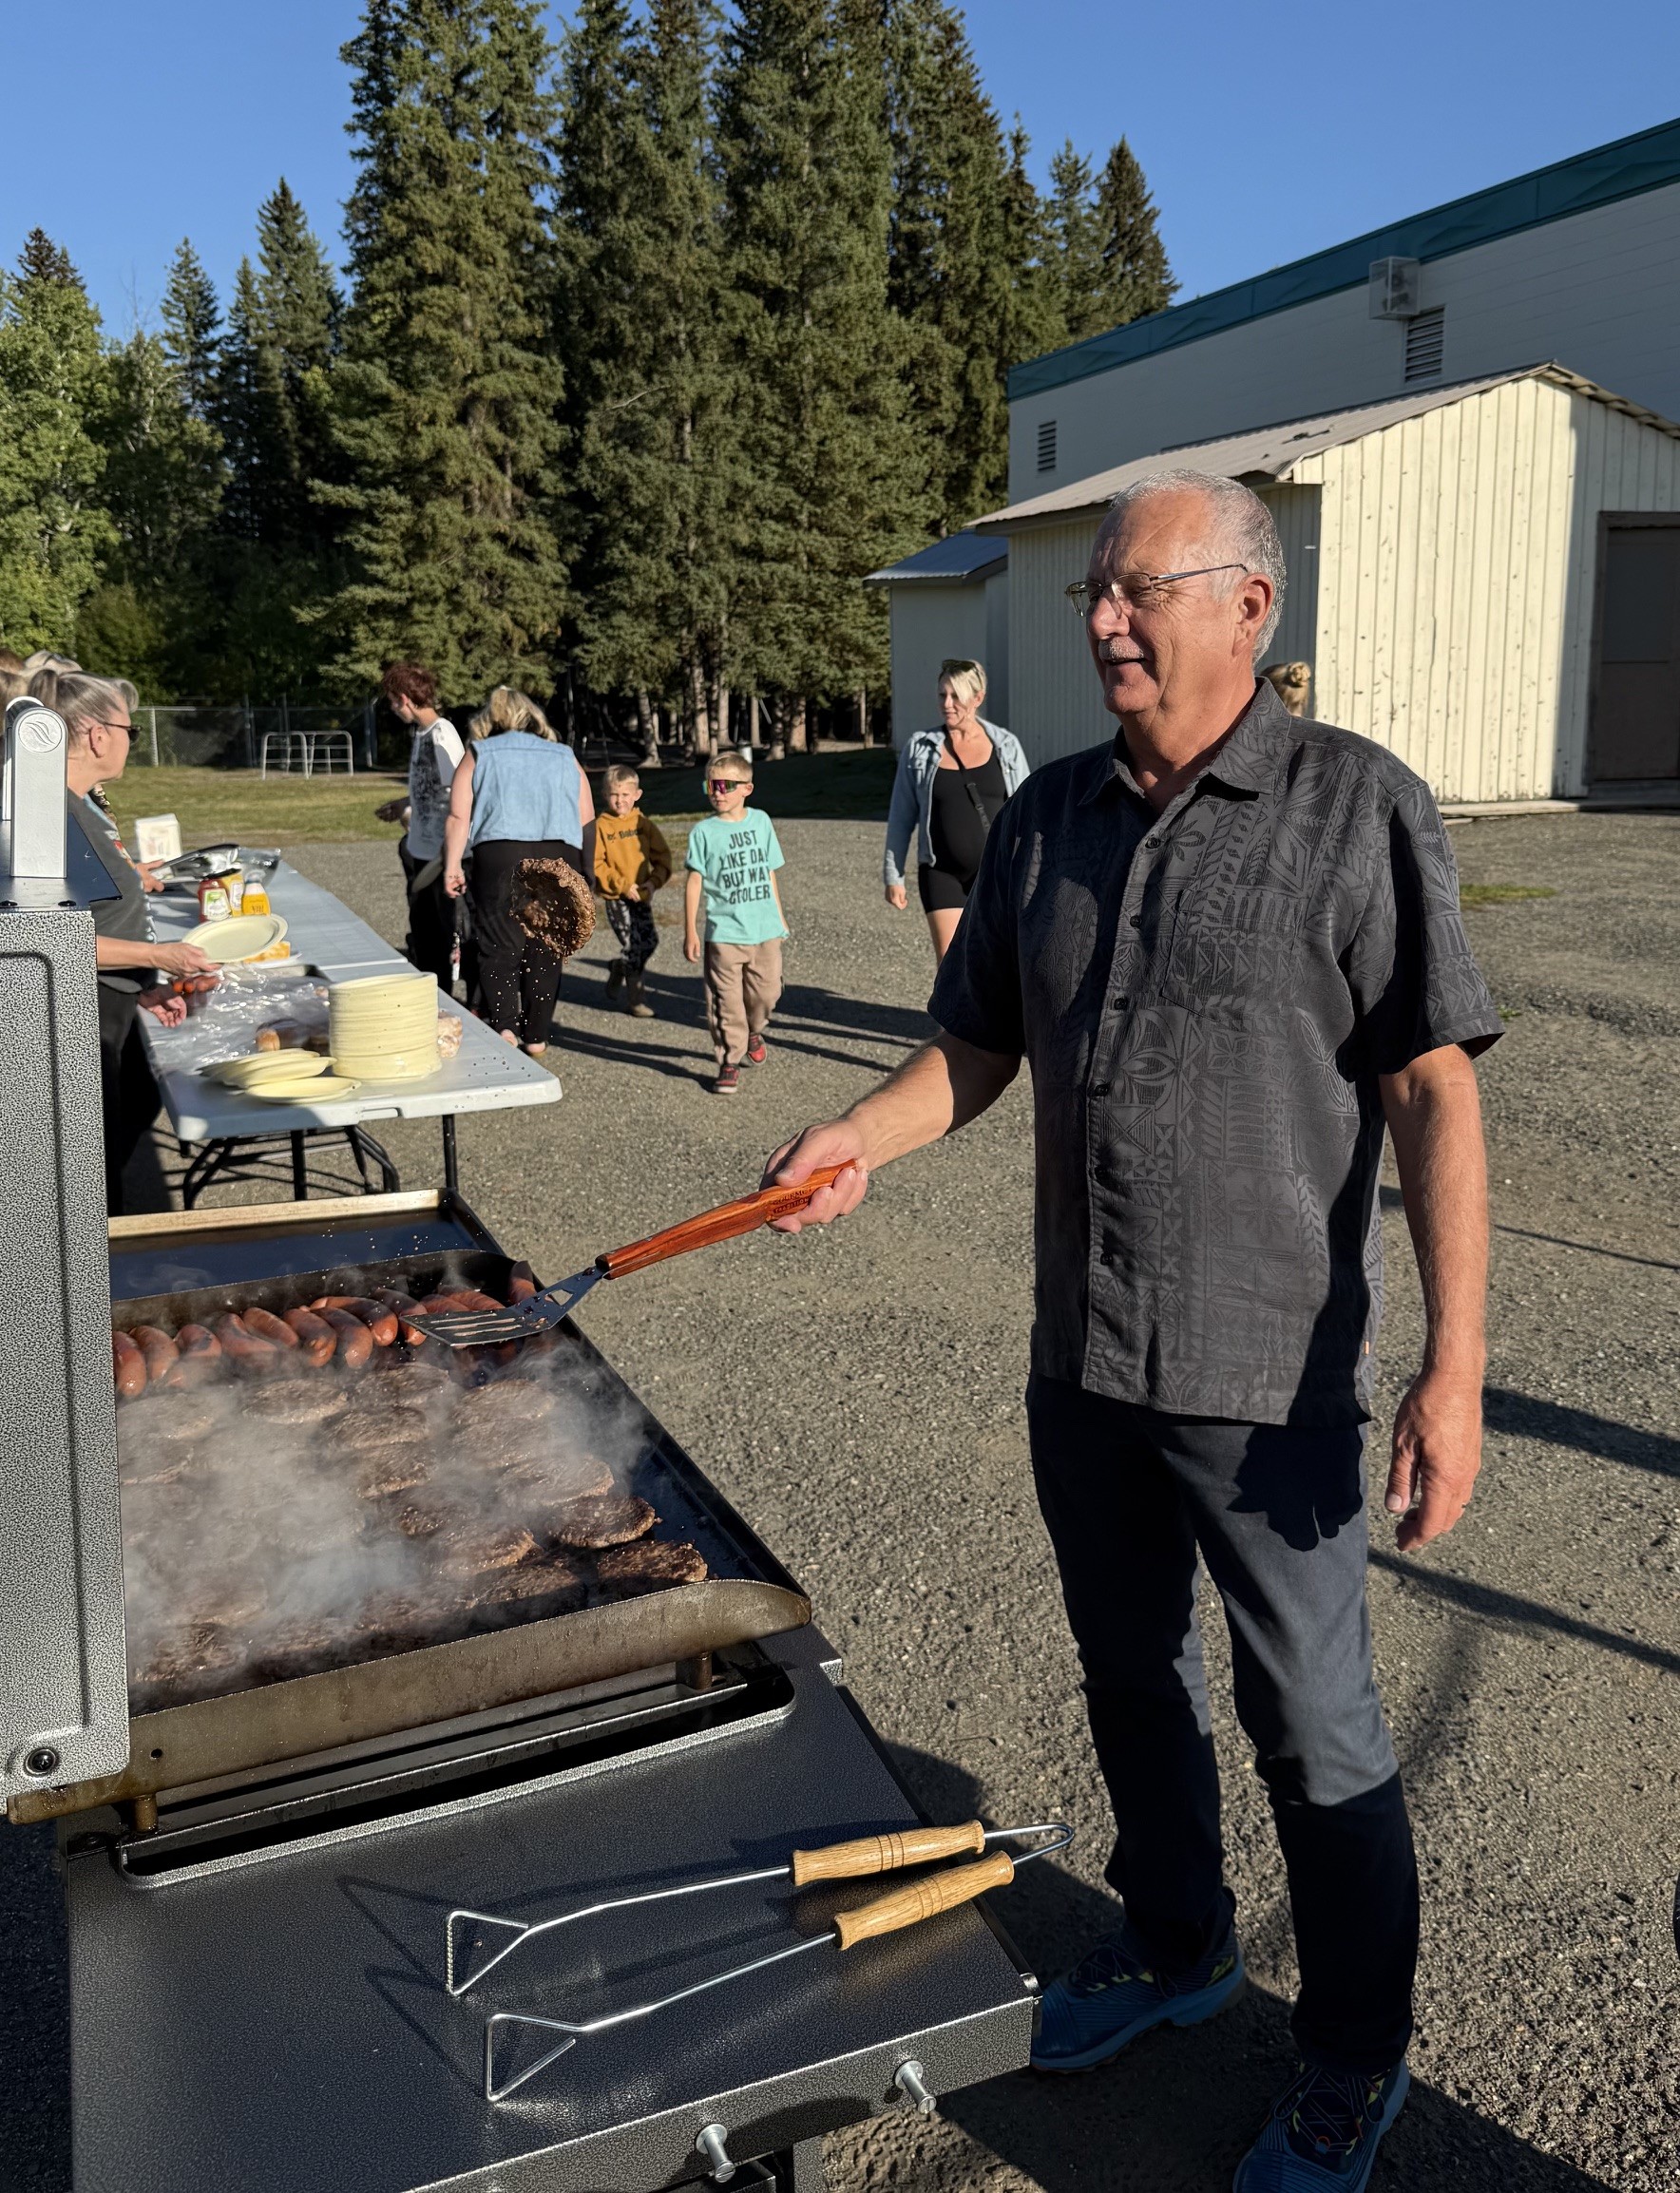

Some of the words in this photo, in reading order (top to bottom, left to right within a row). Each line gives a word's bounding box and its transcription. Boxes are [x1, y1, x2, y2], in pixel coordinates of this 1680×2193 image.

[729, 830, 757, 849] JUST
[719, 850, 747, 871] LIKE
[722, 869, 745, 889] BUT
